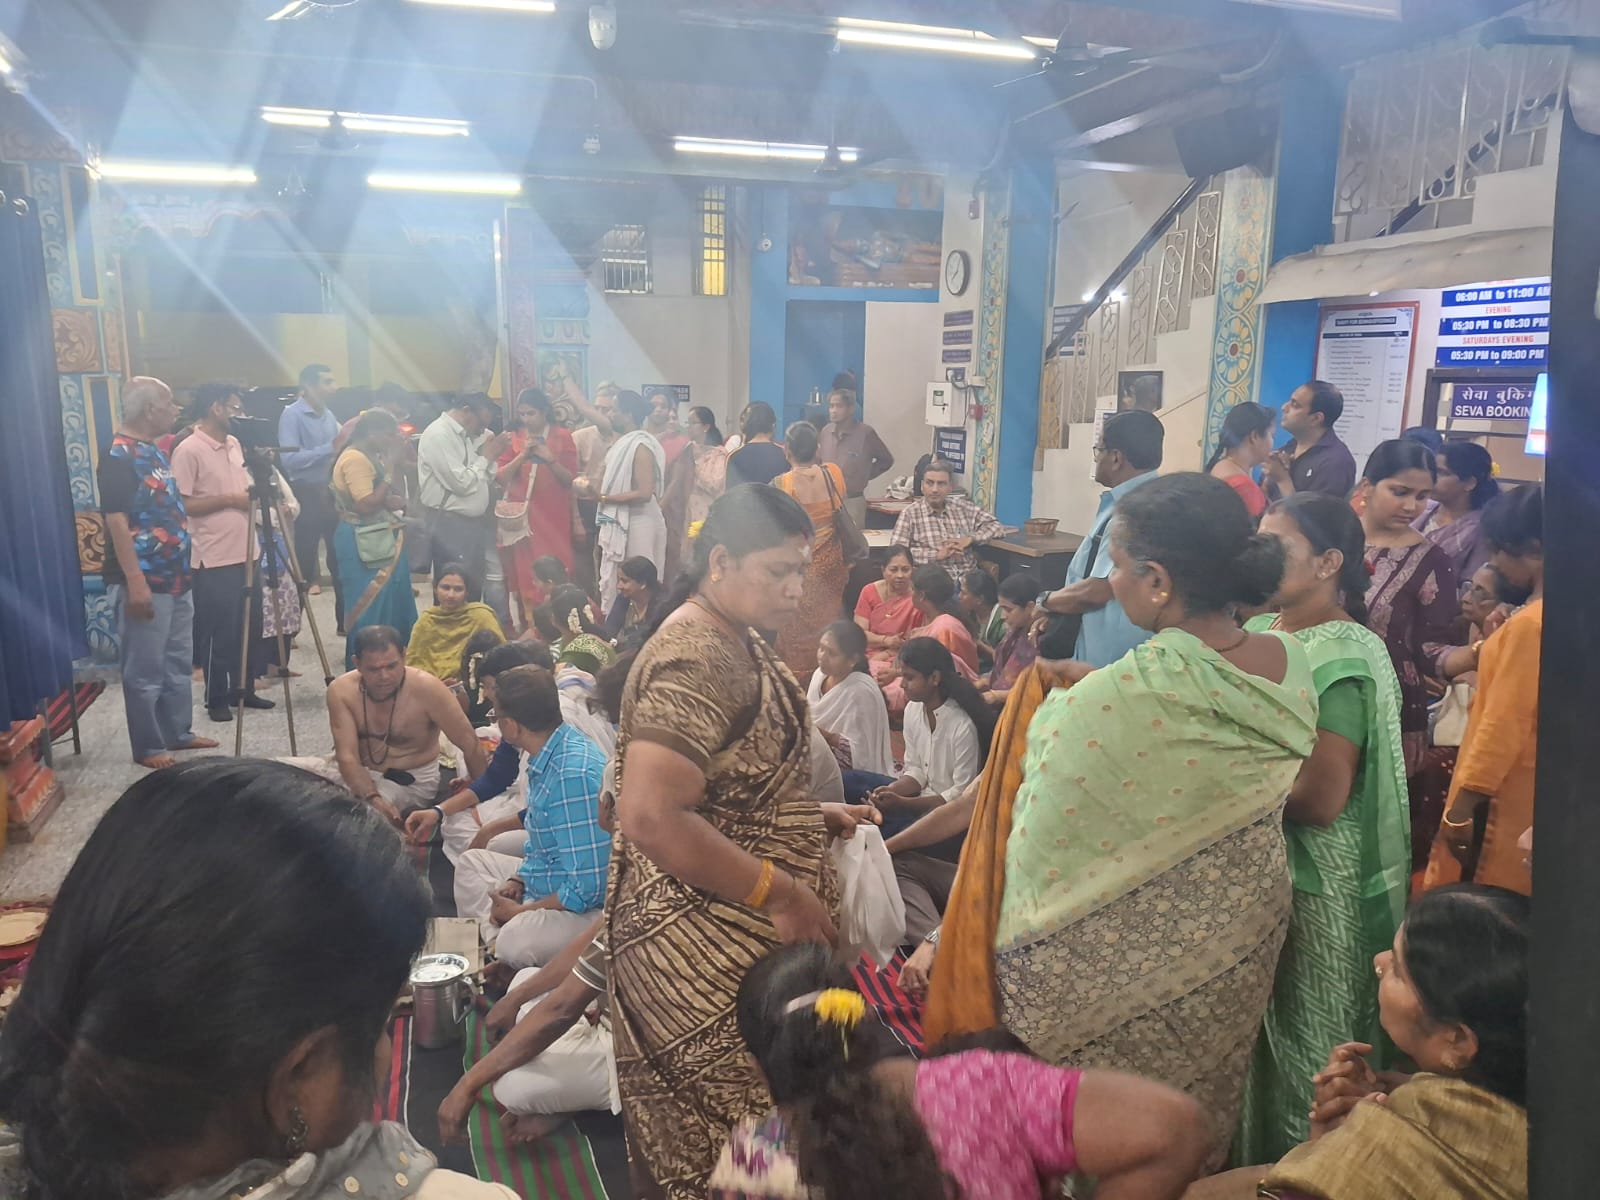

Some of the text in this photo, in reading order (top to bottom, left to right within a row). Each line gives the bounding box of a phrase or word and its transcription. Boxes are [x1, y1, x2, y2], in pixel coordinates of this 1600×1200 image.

[1455, 292, 1478, 302] 06:00
[1479, 290, 1493, 301] AM
[1496, 289, 1506, 300] to
[1507, 287, 1534, 299] 11:00
[1486, 305, 1512, 313] EVENING
[1452, 317, 1549, 330] 05:30 PM to 08:30 PM
[1463, 335, 1534, 345] SATURDAYS EVENING
[1451, 349, 1545, 360] 05:30 PM to 09:00 PM
[1461, 386, 1488, 401] सेवा
[1454, 405, 1531, 418] SEVA BOOKIN
